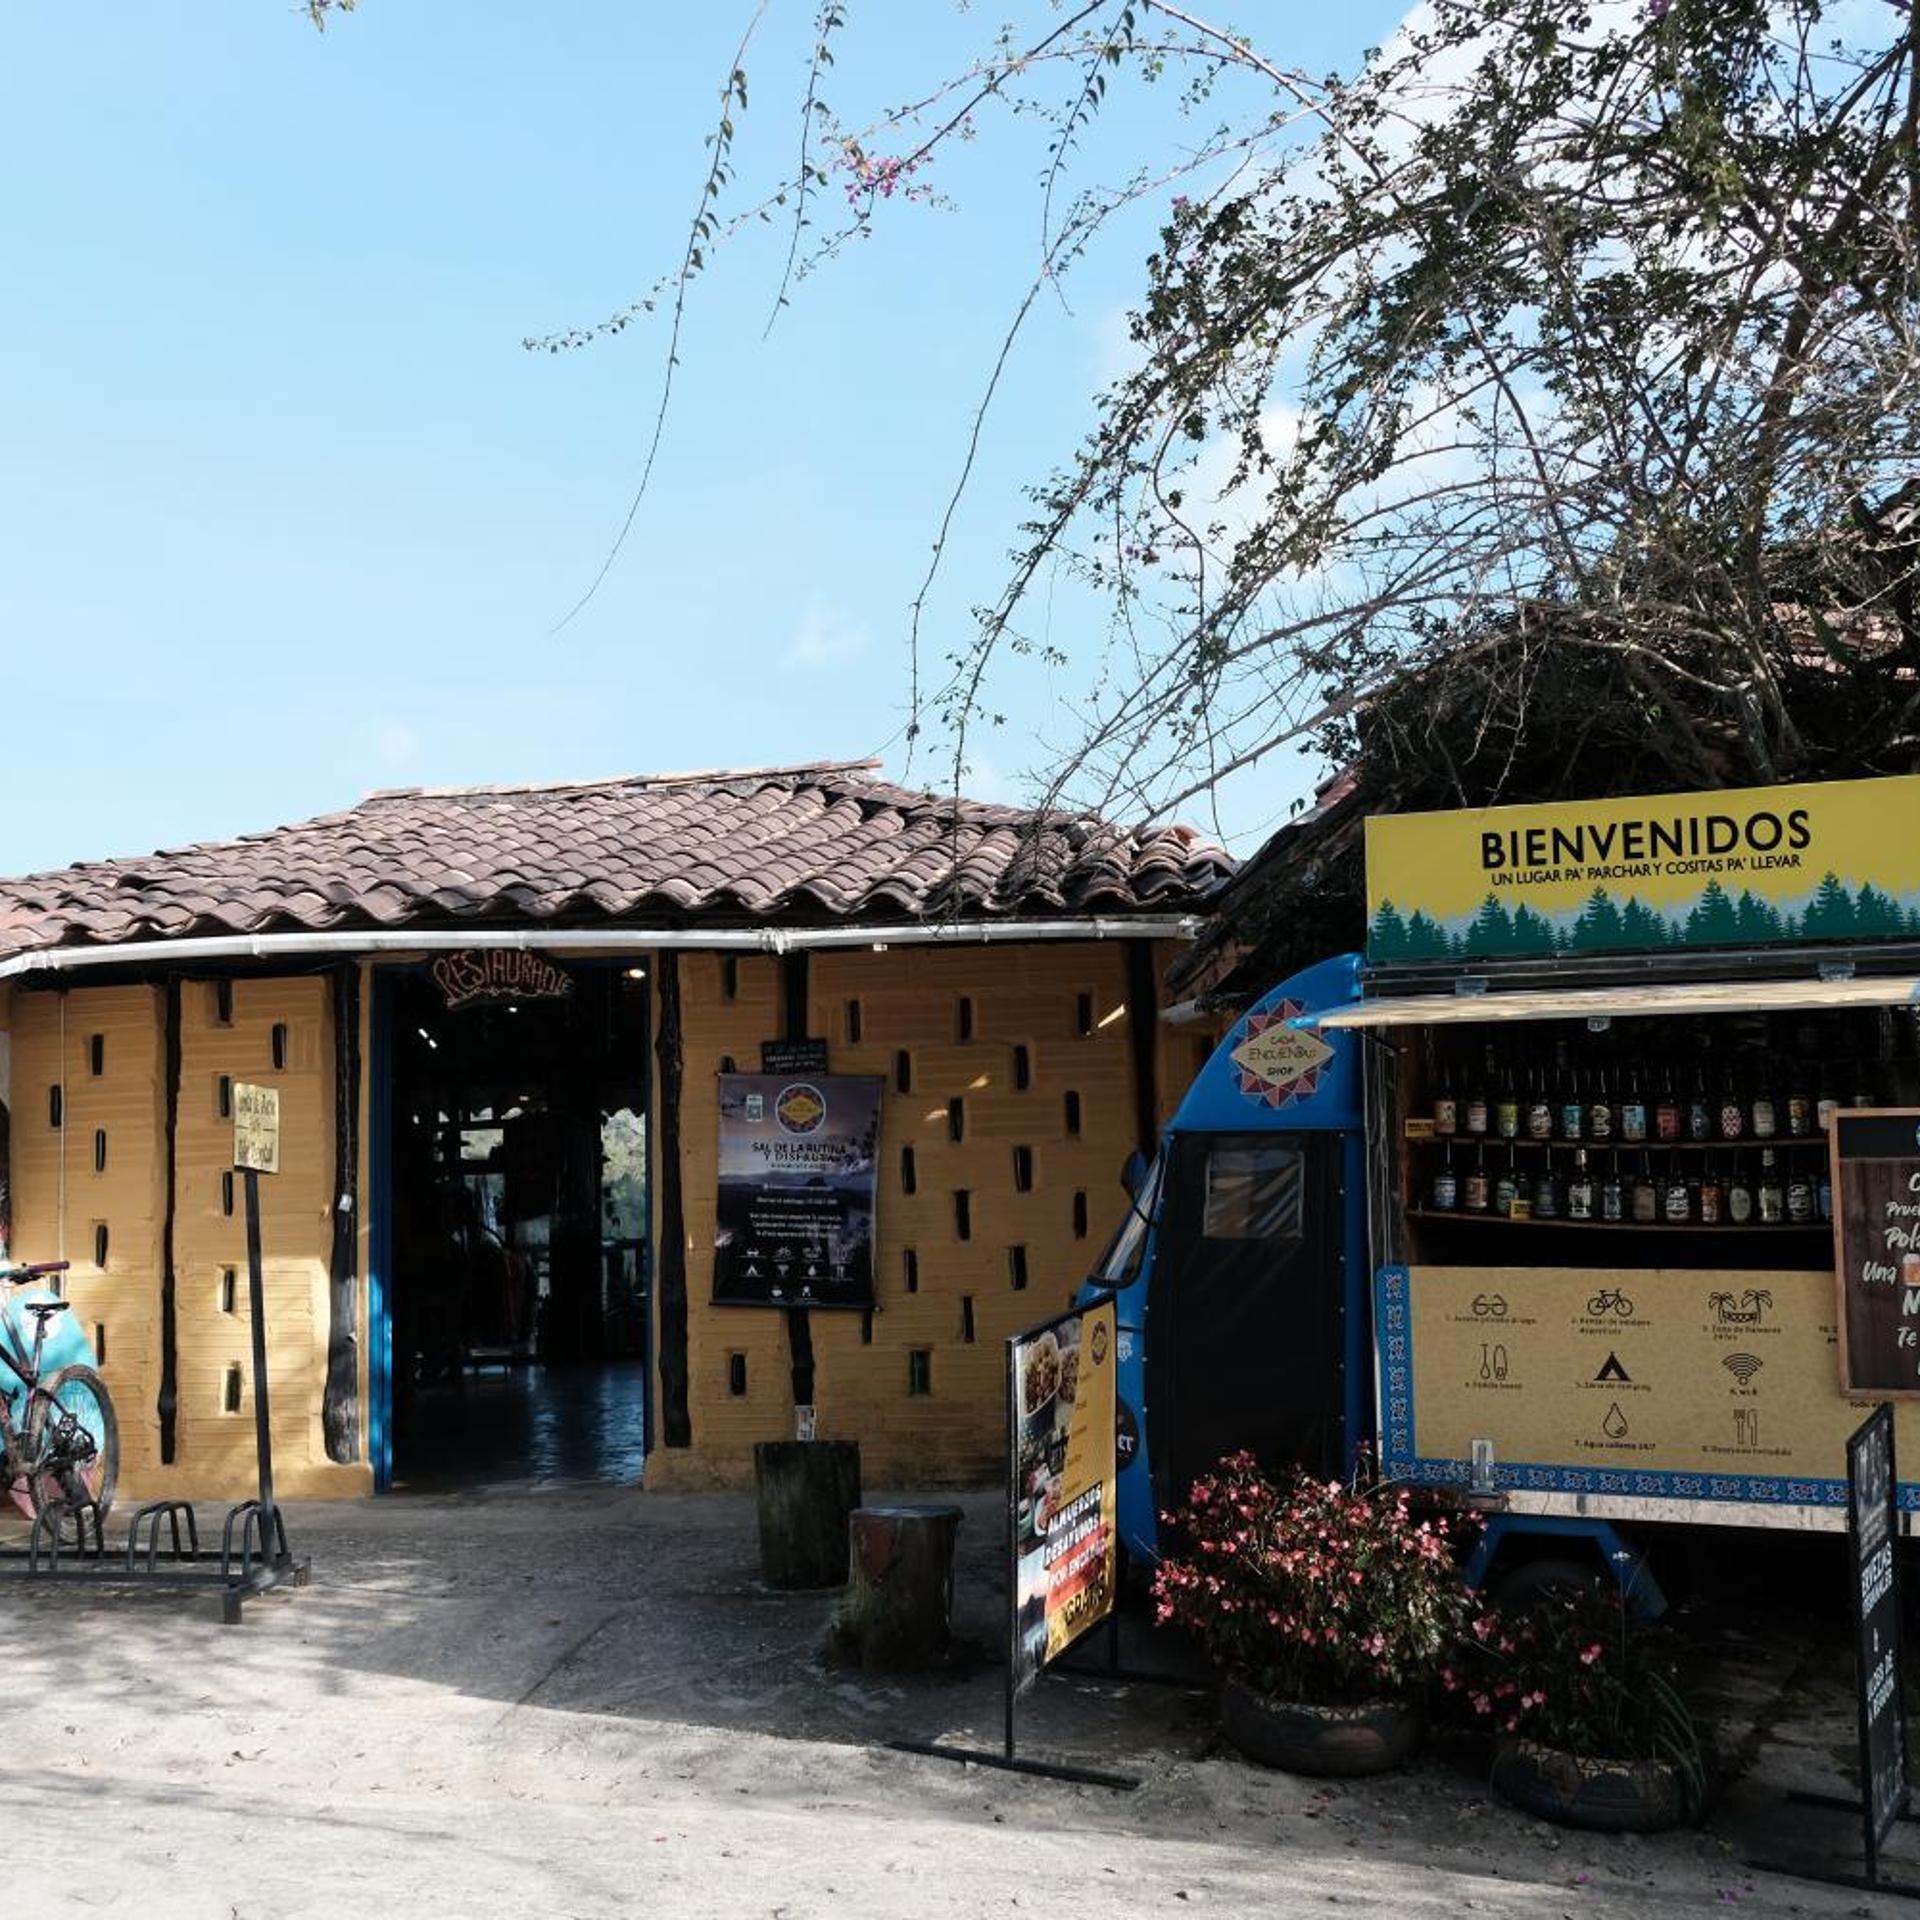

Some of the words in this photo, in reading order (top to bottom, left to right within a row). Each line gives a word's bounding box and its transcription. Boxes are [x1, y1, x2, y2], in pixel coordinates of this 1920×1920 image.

[1481, 810, 1811, 869] BIENVENIDOS
[1491, 871, 1513, 886] UN
[1516, 868, 1561, 884] LUGAR
[1587, 862, 1650, 879] PARCHAR
[1666, 858, 1723, 875] COSITAS
[1727, 856, 1747, 871] PA'
[1751, 853, 1801, 870] LLEVAR
[752, 1142, 771, 1153] SAL
[1885, 1200, 1920, 1219] Prue
[1862, 1261, 1898, 1286] Una
